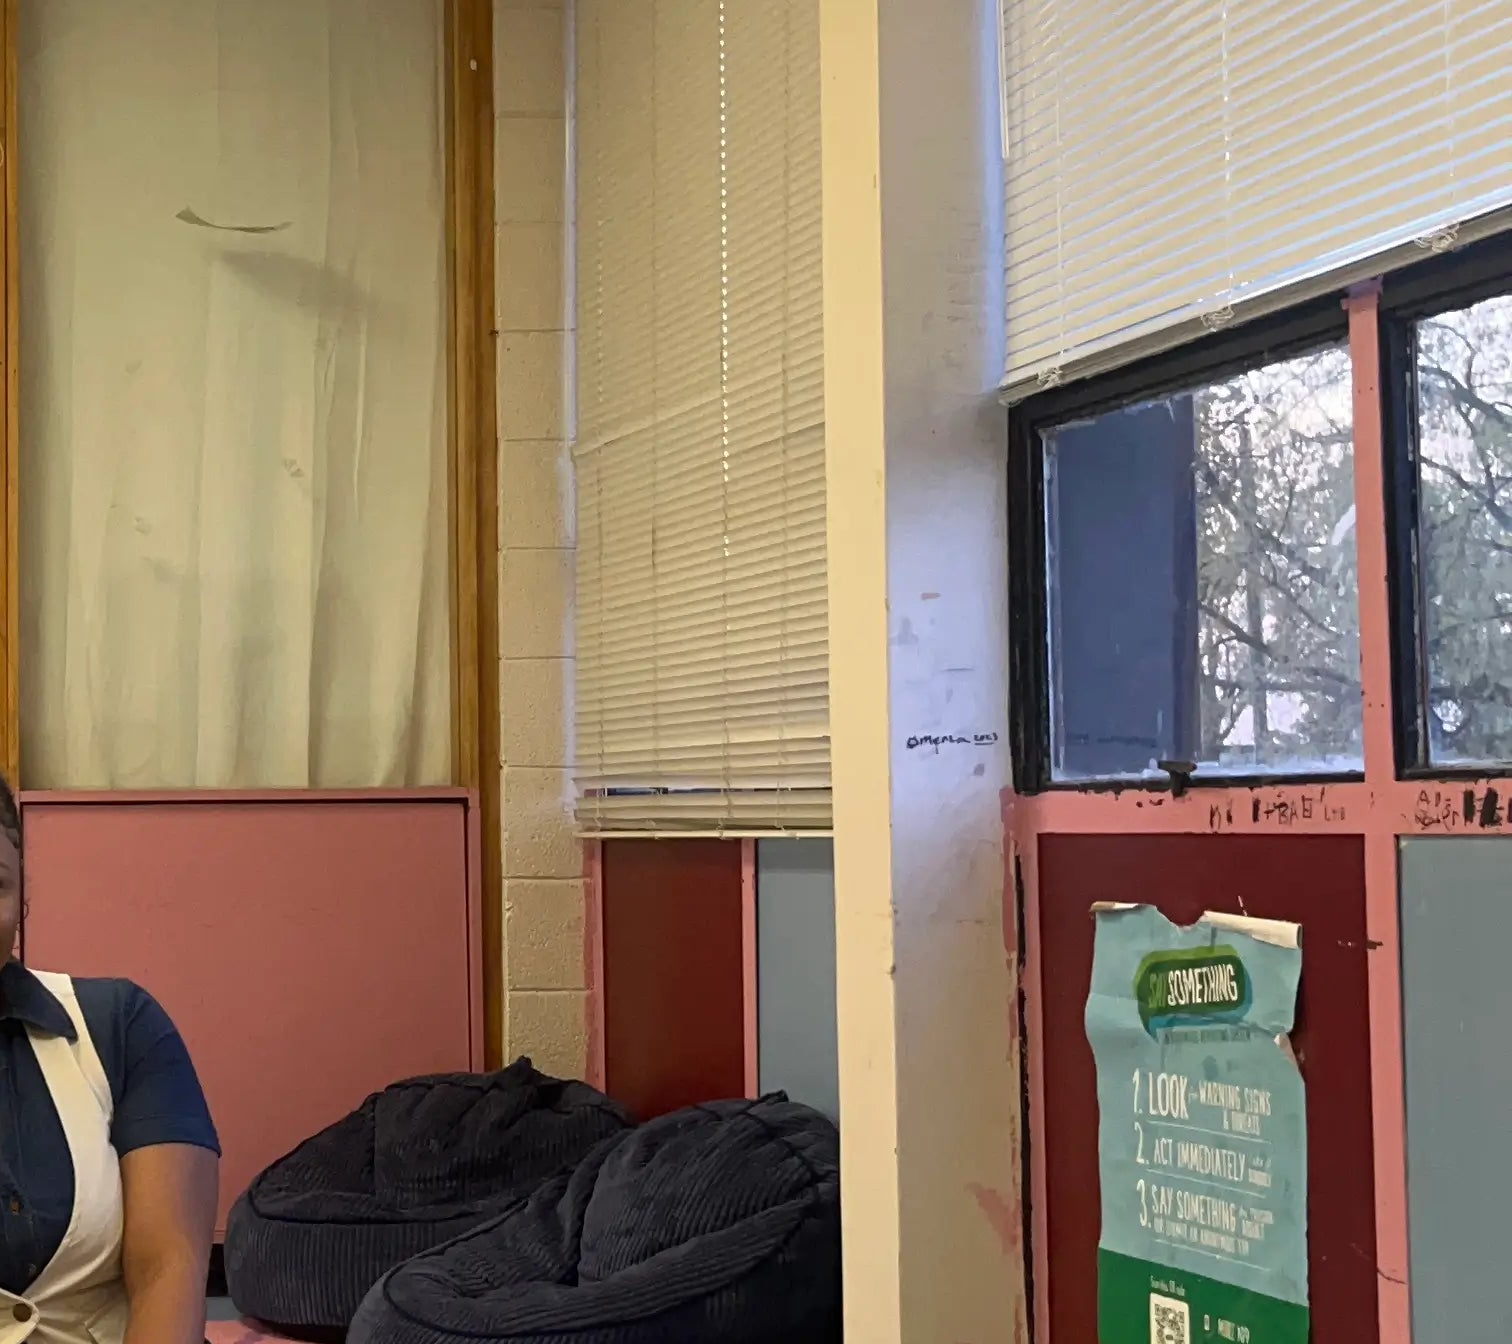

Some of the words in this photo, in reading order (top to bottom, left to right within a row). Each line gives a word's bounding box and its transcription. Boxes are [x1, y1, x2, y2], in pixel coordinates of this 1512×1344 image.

[1168, 964, 1238, 1006] SOMETHING
[1132, 1067, 1143, 1114] 1.
[1148, 1071, 1189, 1120] LOOK
[1199, 1080, 1240, 1110] WARNING
[1134, 1121, 1150, 1165] 2.
[1153, 1137, 1173, 1167] ACT
[1177, 1140, 1246, 1182] IMMEDIATELY
[1136, 1179, 1151, 1229] 3.
[1151, 1184, 1173, 1216] SAY
[1176, 1190, 1236, 1232] SOMETHING
